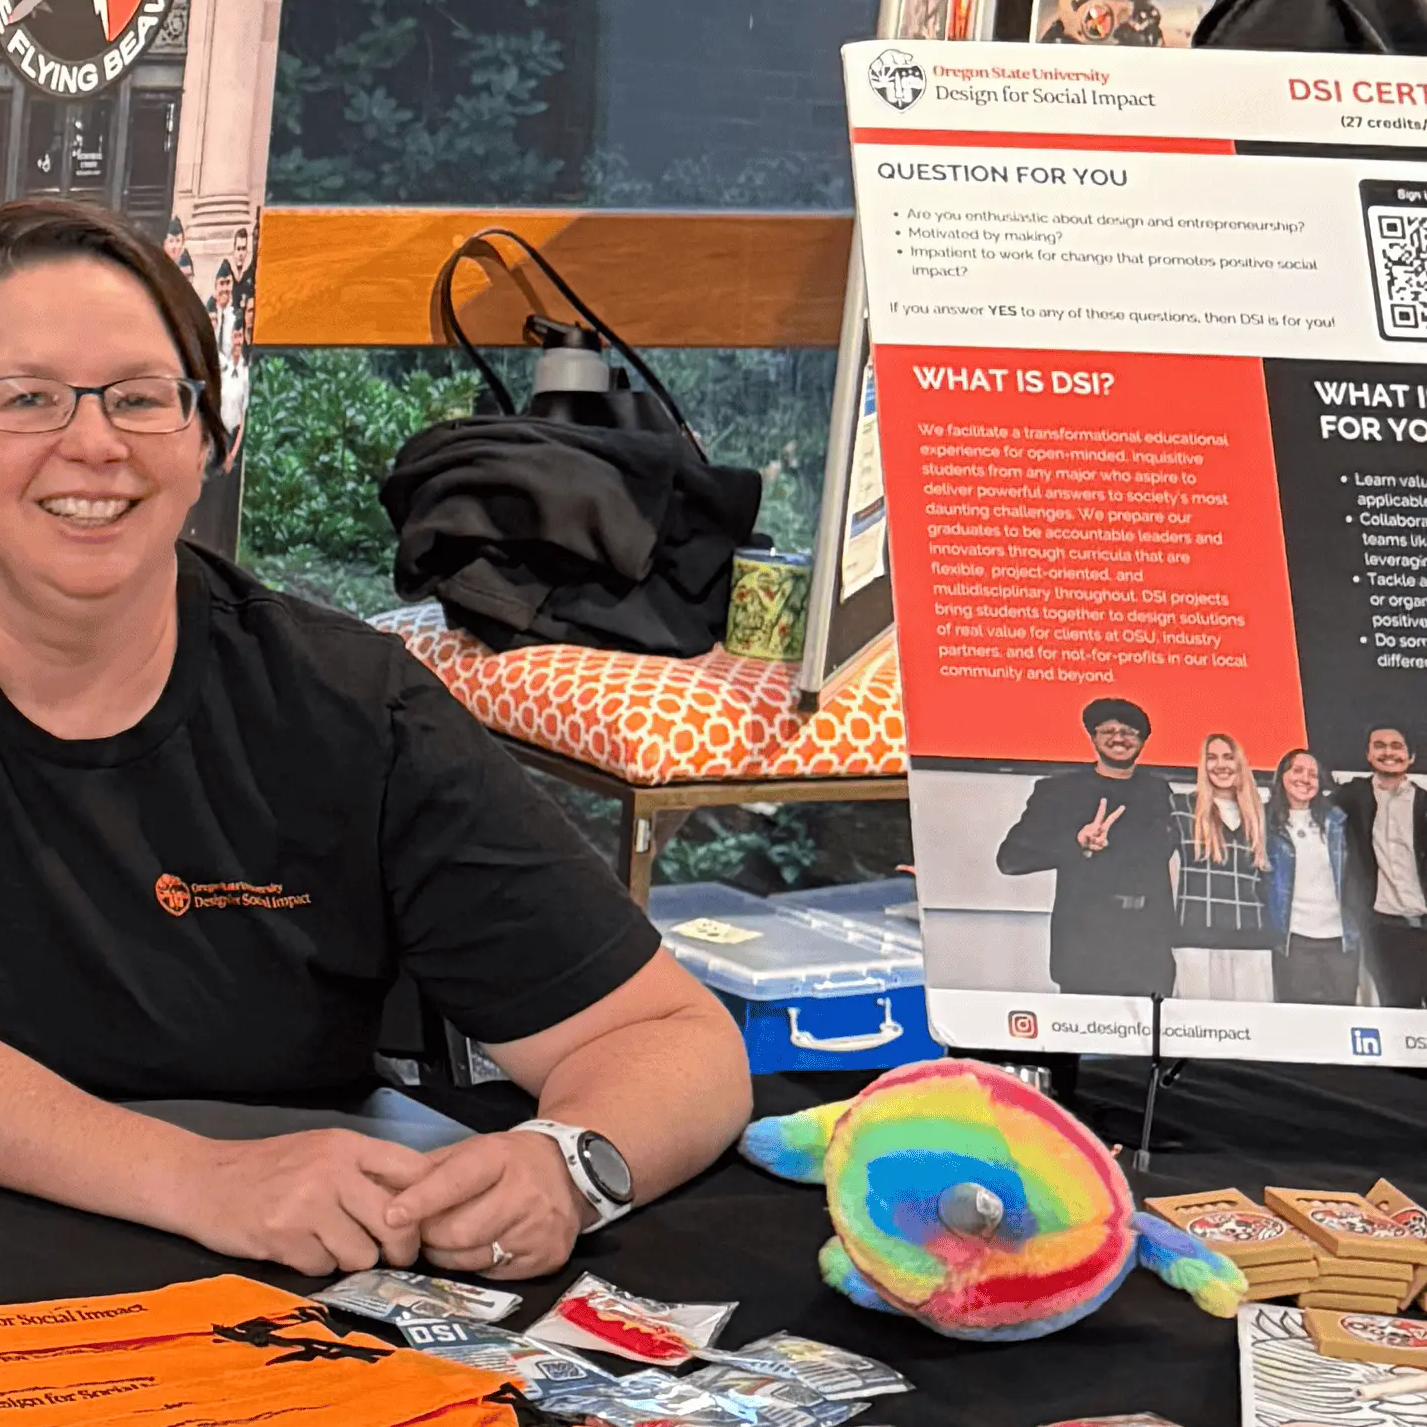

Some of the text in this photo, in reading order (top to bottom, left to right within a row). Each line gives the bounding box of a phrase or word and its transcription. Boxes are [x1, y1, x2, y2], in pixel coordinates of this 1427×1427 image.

[7, 28, 98, 94] FLYING
[932, 64, 1110, 86] Oregon State University
[934, 84, 1156, 111] Design for Social Impact
[1288, 78, 1342, 103] DSI
[1341, 115, 1363, 128] (27
[876, 161, 1127, 186] QUESTION FOR YOU
[906, 207, 1305, 234] Are you enthusiastic about design and entrepreneurship?
[907, 226, 1063, 245] Motivated by making?
[909, 245, 1318, 270] Impatient to work for change that promotes positive social
[911, 264, 968, 279] impact?
[889, 301, 1335, 330] If you answer YES to any of these questions, then DSI is for you!
[912, 365, 1114, 395] WHAT IS DSI?
[1314, 381, 1409, 408] WHAT
[917, 422, 1229, 446] We facilitate a transformational educational
[1320, 415, 1382, 442] FOR
[919, 444, 1000, 458] experience
[1002, 444, 1024, 458] for
[1131, 449, 1203, 465] inquisitive
[921, 461, 1197, 486] students from any major who aspire to
[1354, 472, 1395, 488] Learn
[1362, 533, 1407, 547] teams
[1367, 572, 1416, 587] Tackle
[1369, 595, 1385, 606] or
[934, 601, 1245, 627] bring students together to design solutions
[1375, 632, 1396, 646] Do
[407, 1323, 469, 1343] DSI
[46, 1391, 76, 1405] for
